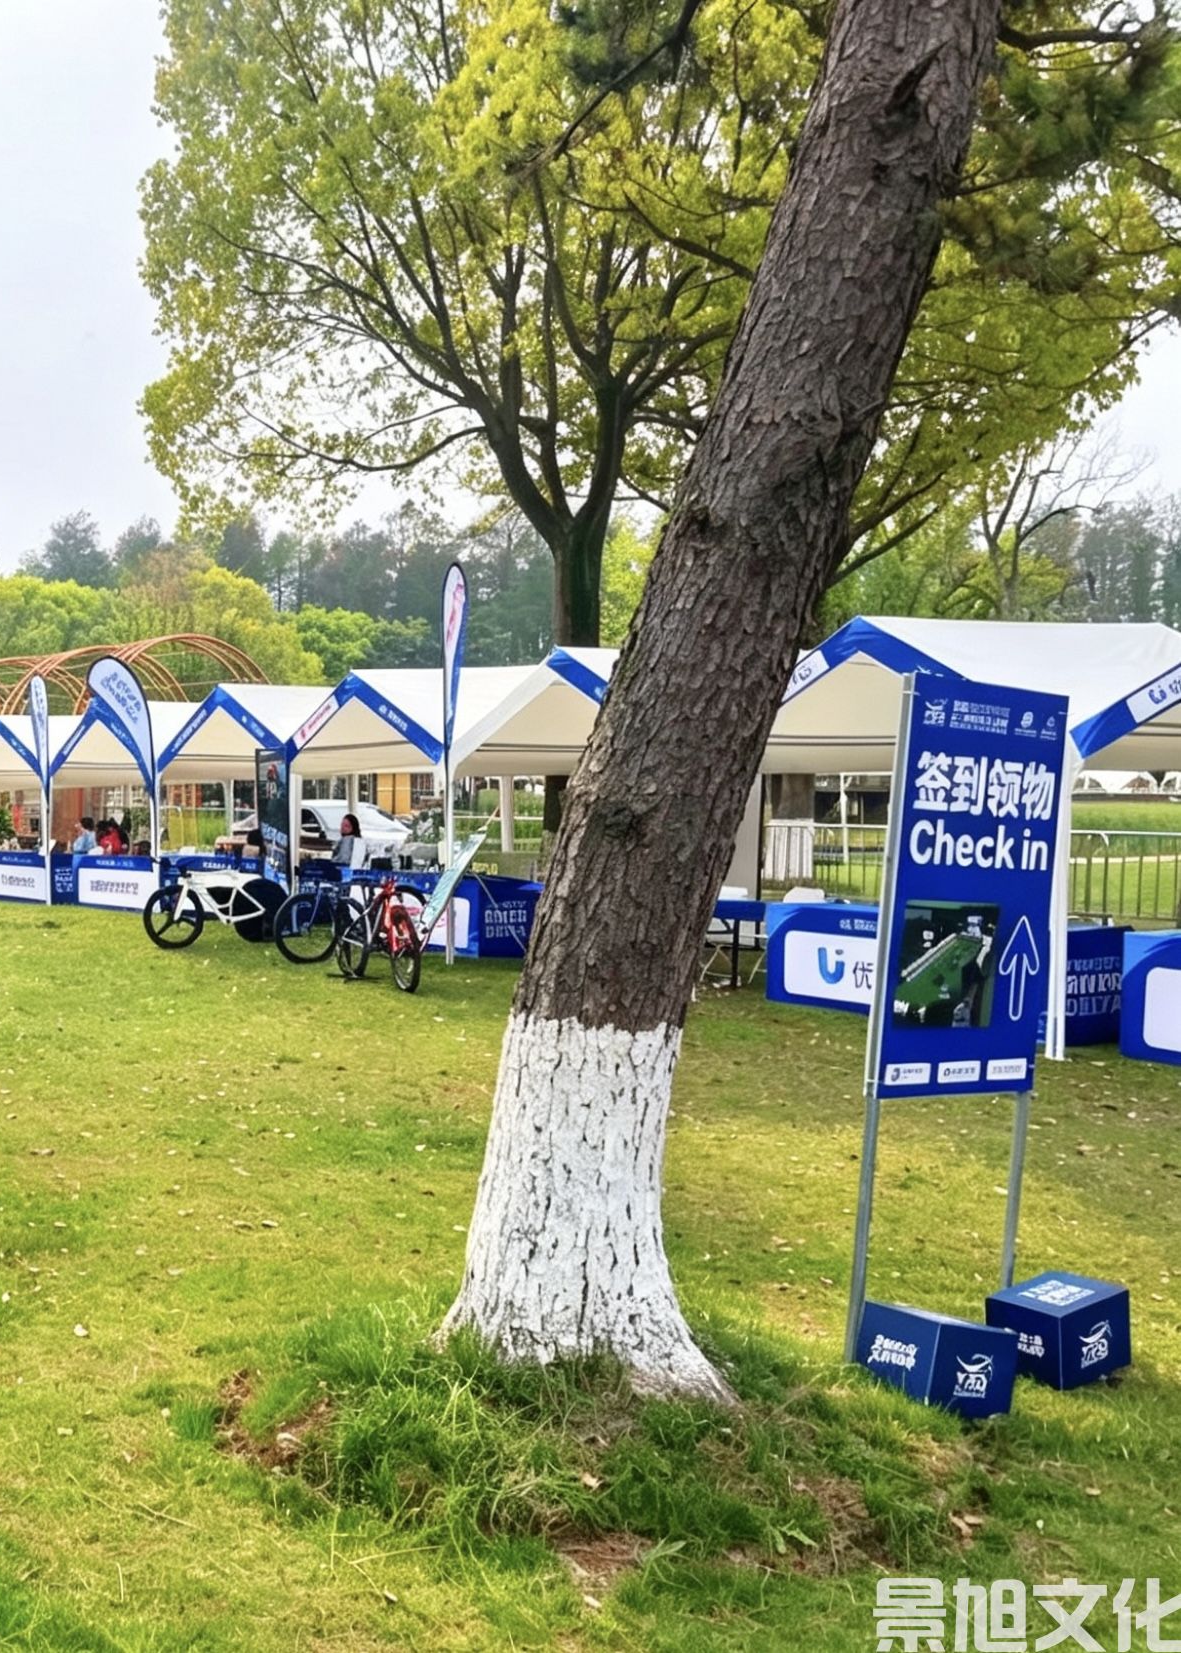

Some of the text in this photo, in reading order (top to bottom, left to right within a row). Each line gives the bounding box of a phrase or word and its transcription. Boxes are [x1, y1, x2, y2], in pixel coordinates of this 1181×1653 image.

[913, 751, 1055, 821] 签到领物
[909, 819, 1048, 871] Check in
